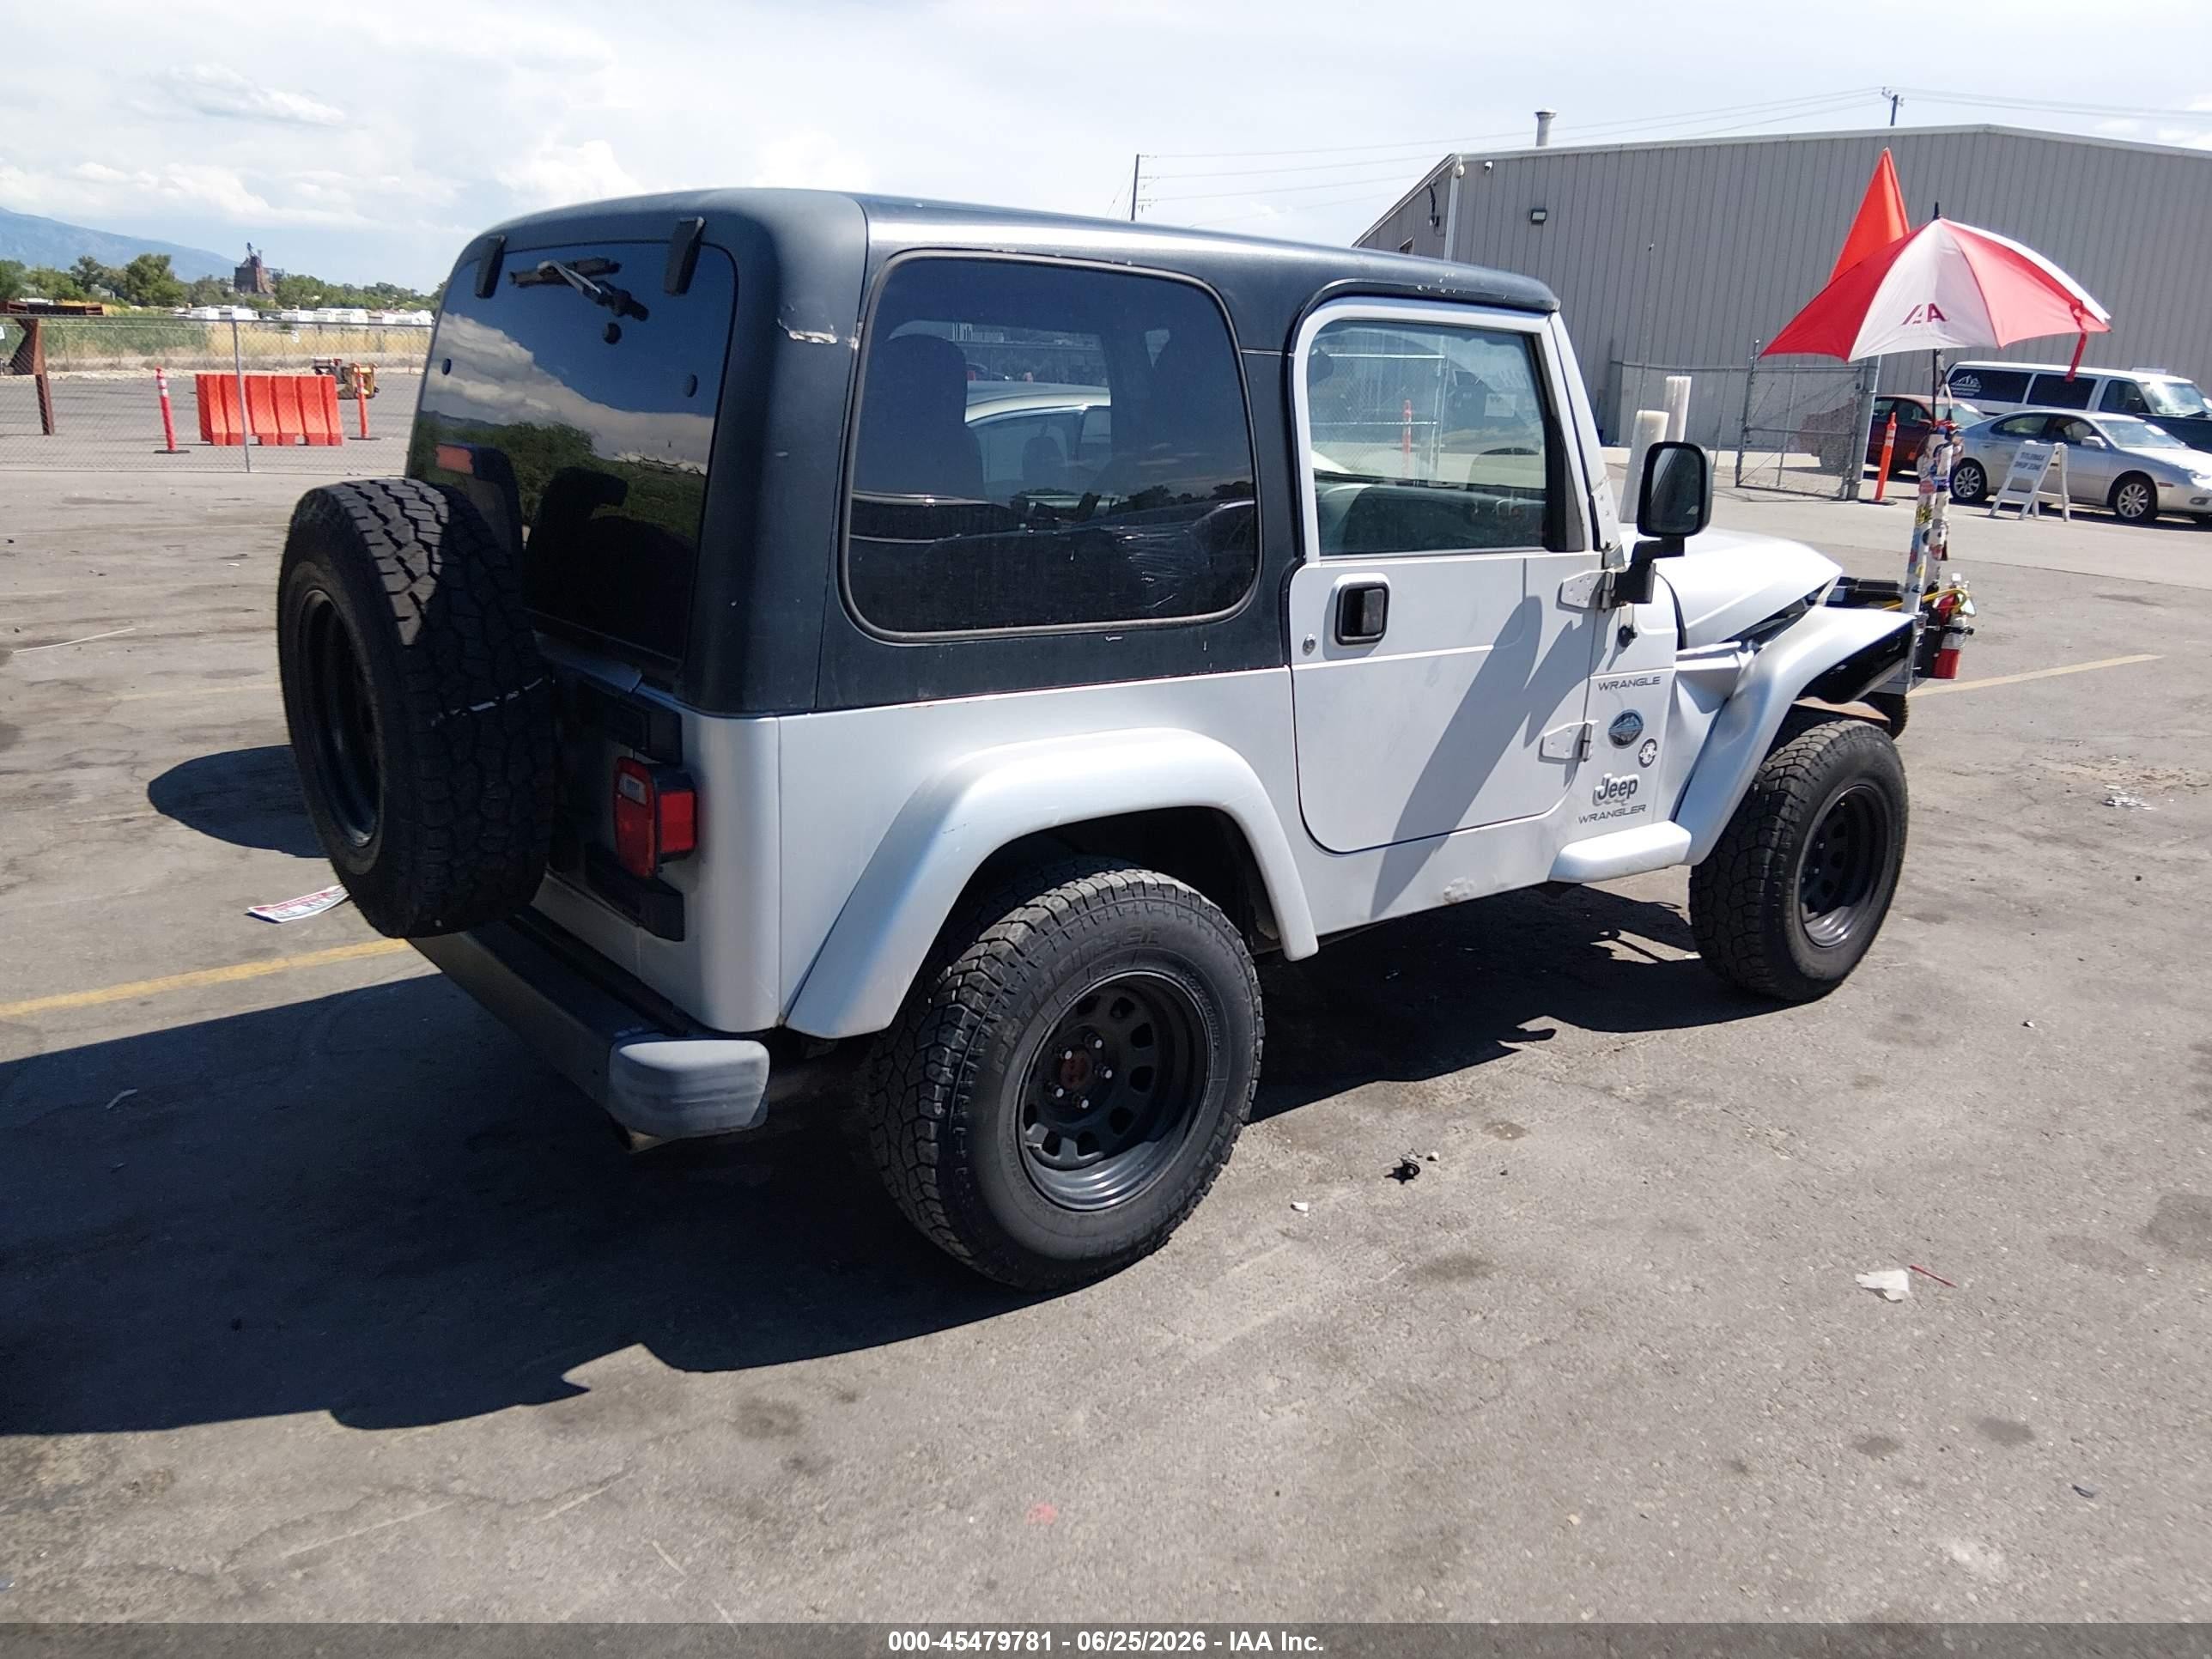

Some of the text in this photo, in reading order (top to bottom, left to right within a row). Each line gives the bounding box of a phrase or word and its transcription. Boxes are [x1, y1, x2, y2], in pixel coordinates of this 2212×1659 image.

[1598, 676, 1661, 690] WRANGLE
[1595, 773, 1639, 806] Jeep
[1578, 805, 1646, 824] WRANGLER
